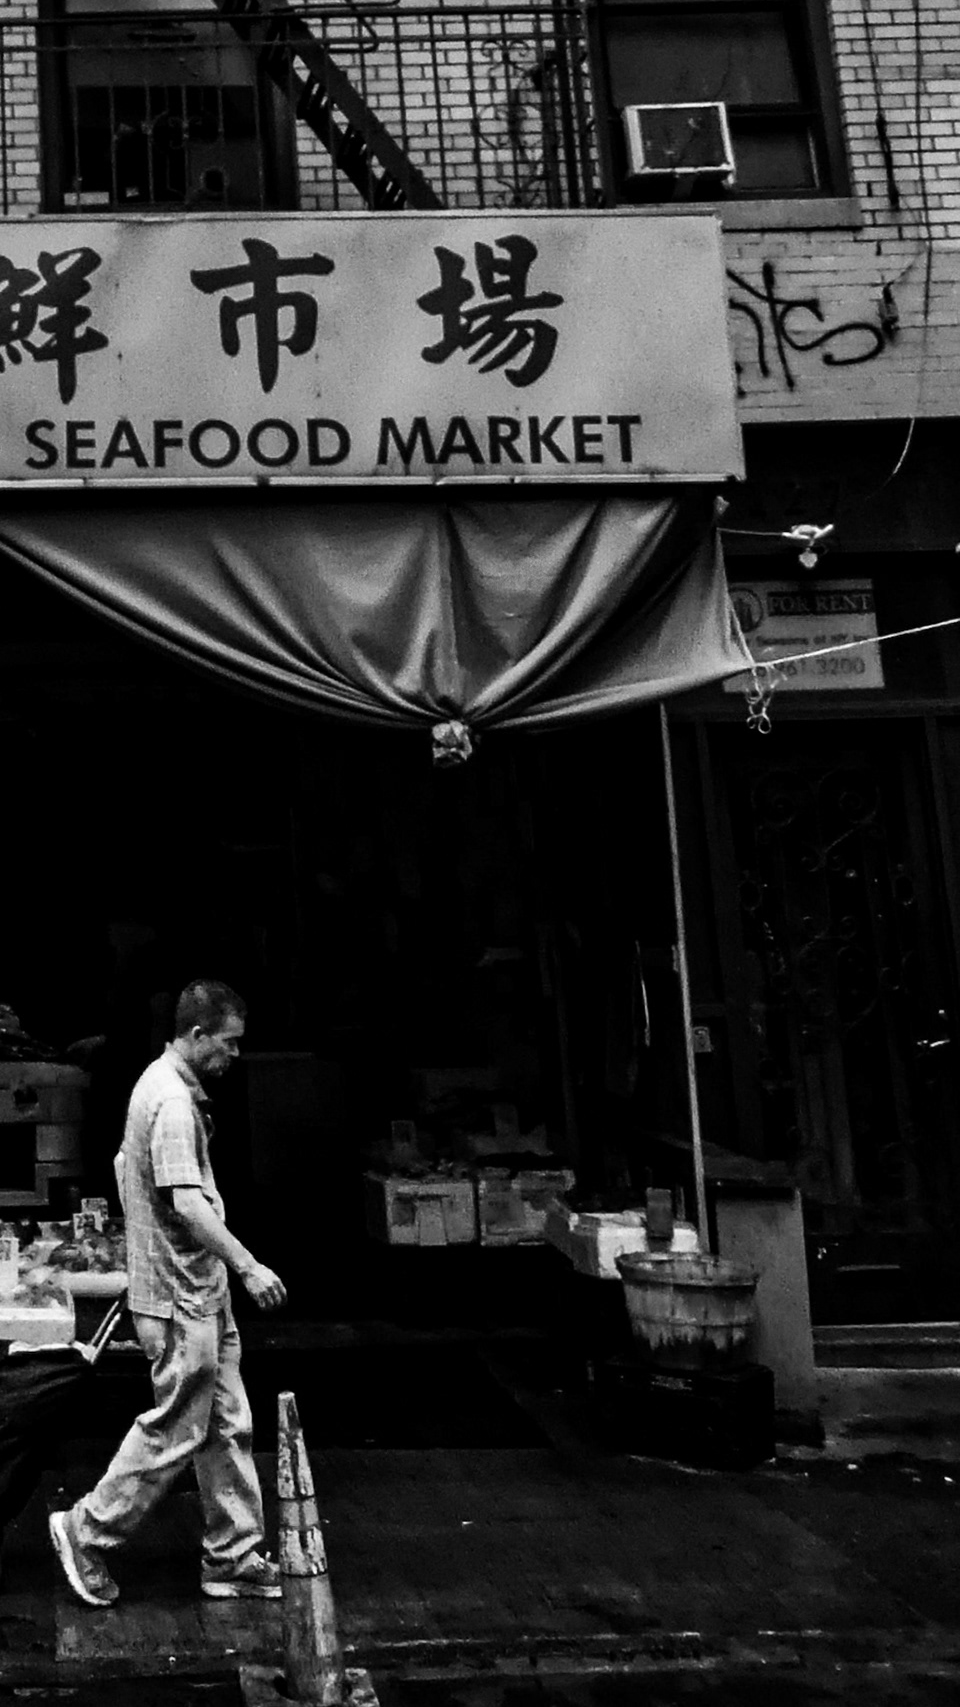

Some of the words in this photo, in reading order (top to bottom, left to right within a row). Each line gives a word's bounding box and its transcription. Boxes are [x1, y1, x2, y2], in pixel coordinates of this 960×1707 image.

[25, 419, 351, 471] SEAFOOD
[377, 415, 642, 466] MARKET
[770, 596, 812, 612] FOR
[817, 593, 871, 611] RENT
